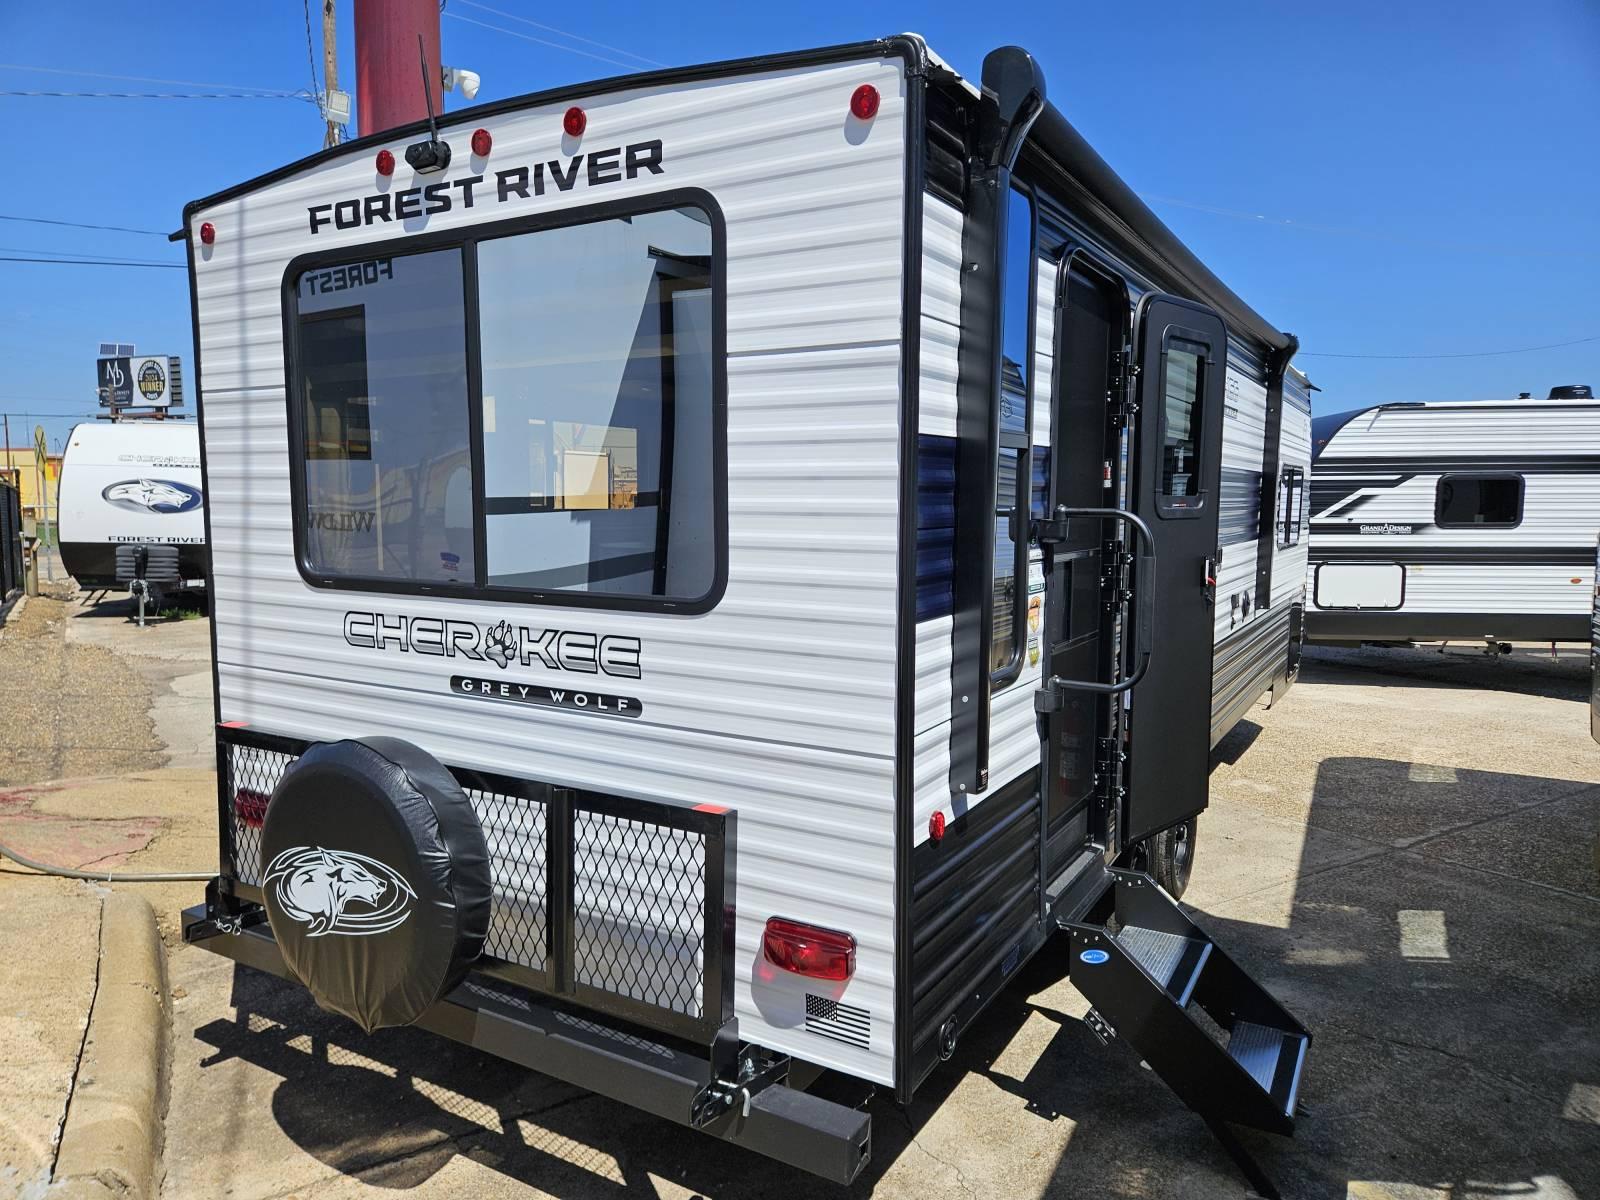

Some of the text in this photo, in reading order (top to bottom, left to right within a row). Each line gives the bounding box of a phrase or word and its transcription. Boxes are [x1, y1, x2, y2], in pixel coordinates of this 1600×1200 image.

[308, 139, 664, 234] FOREST RIVER
[140, 381, 164, 392] WINNER
[108, 535, 163, 543] FOREST
[461, 678, 629, 712] GREY WOLF
